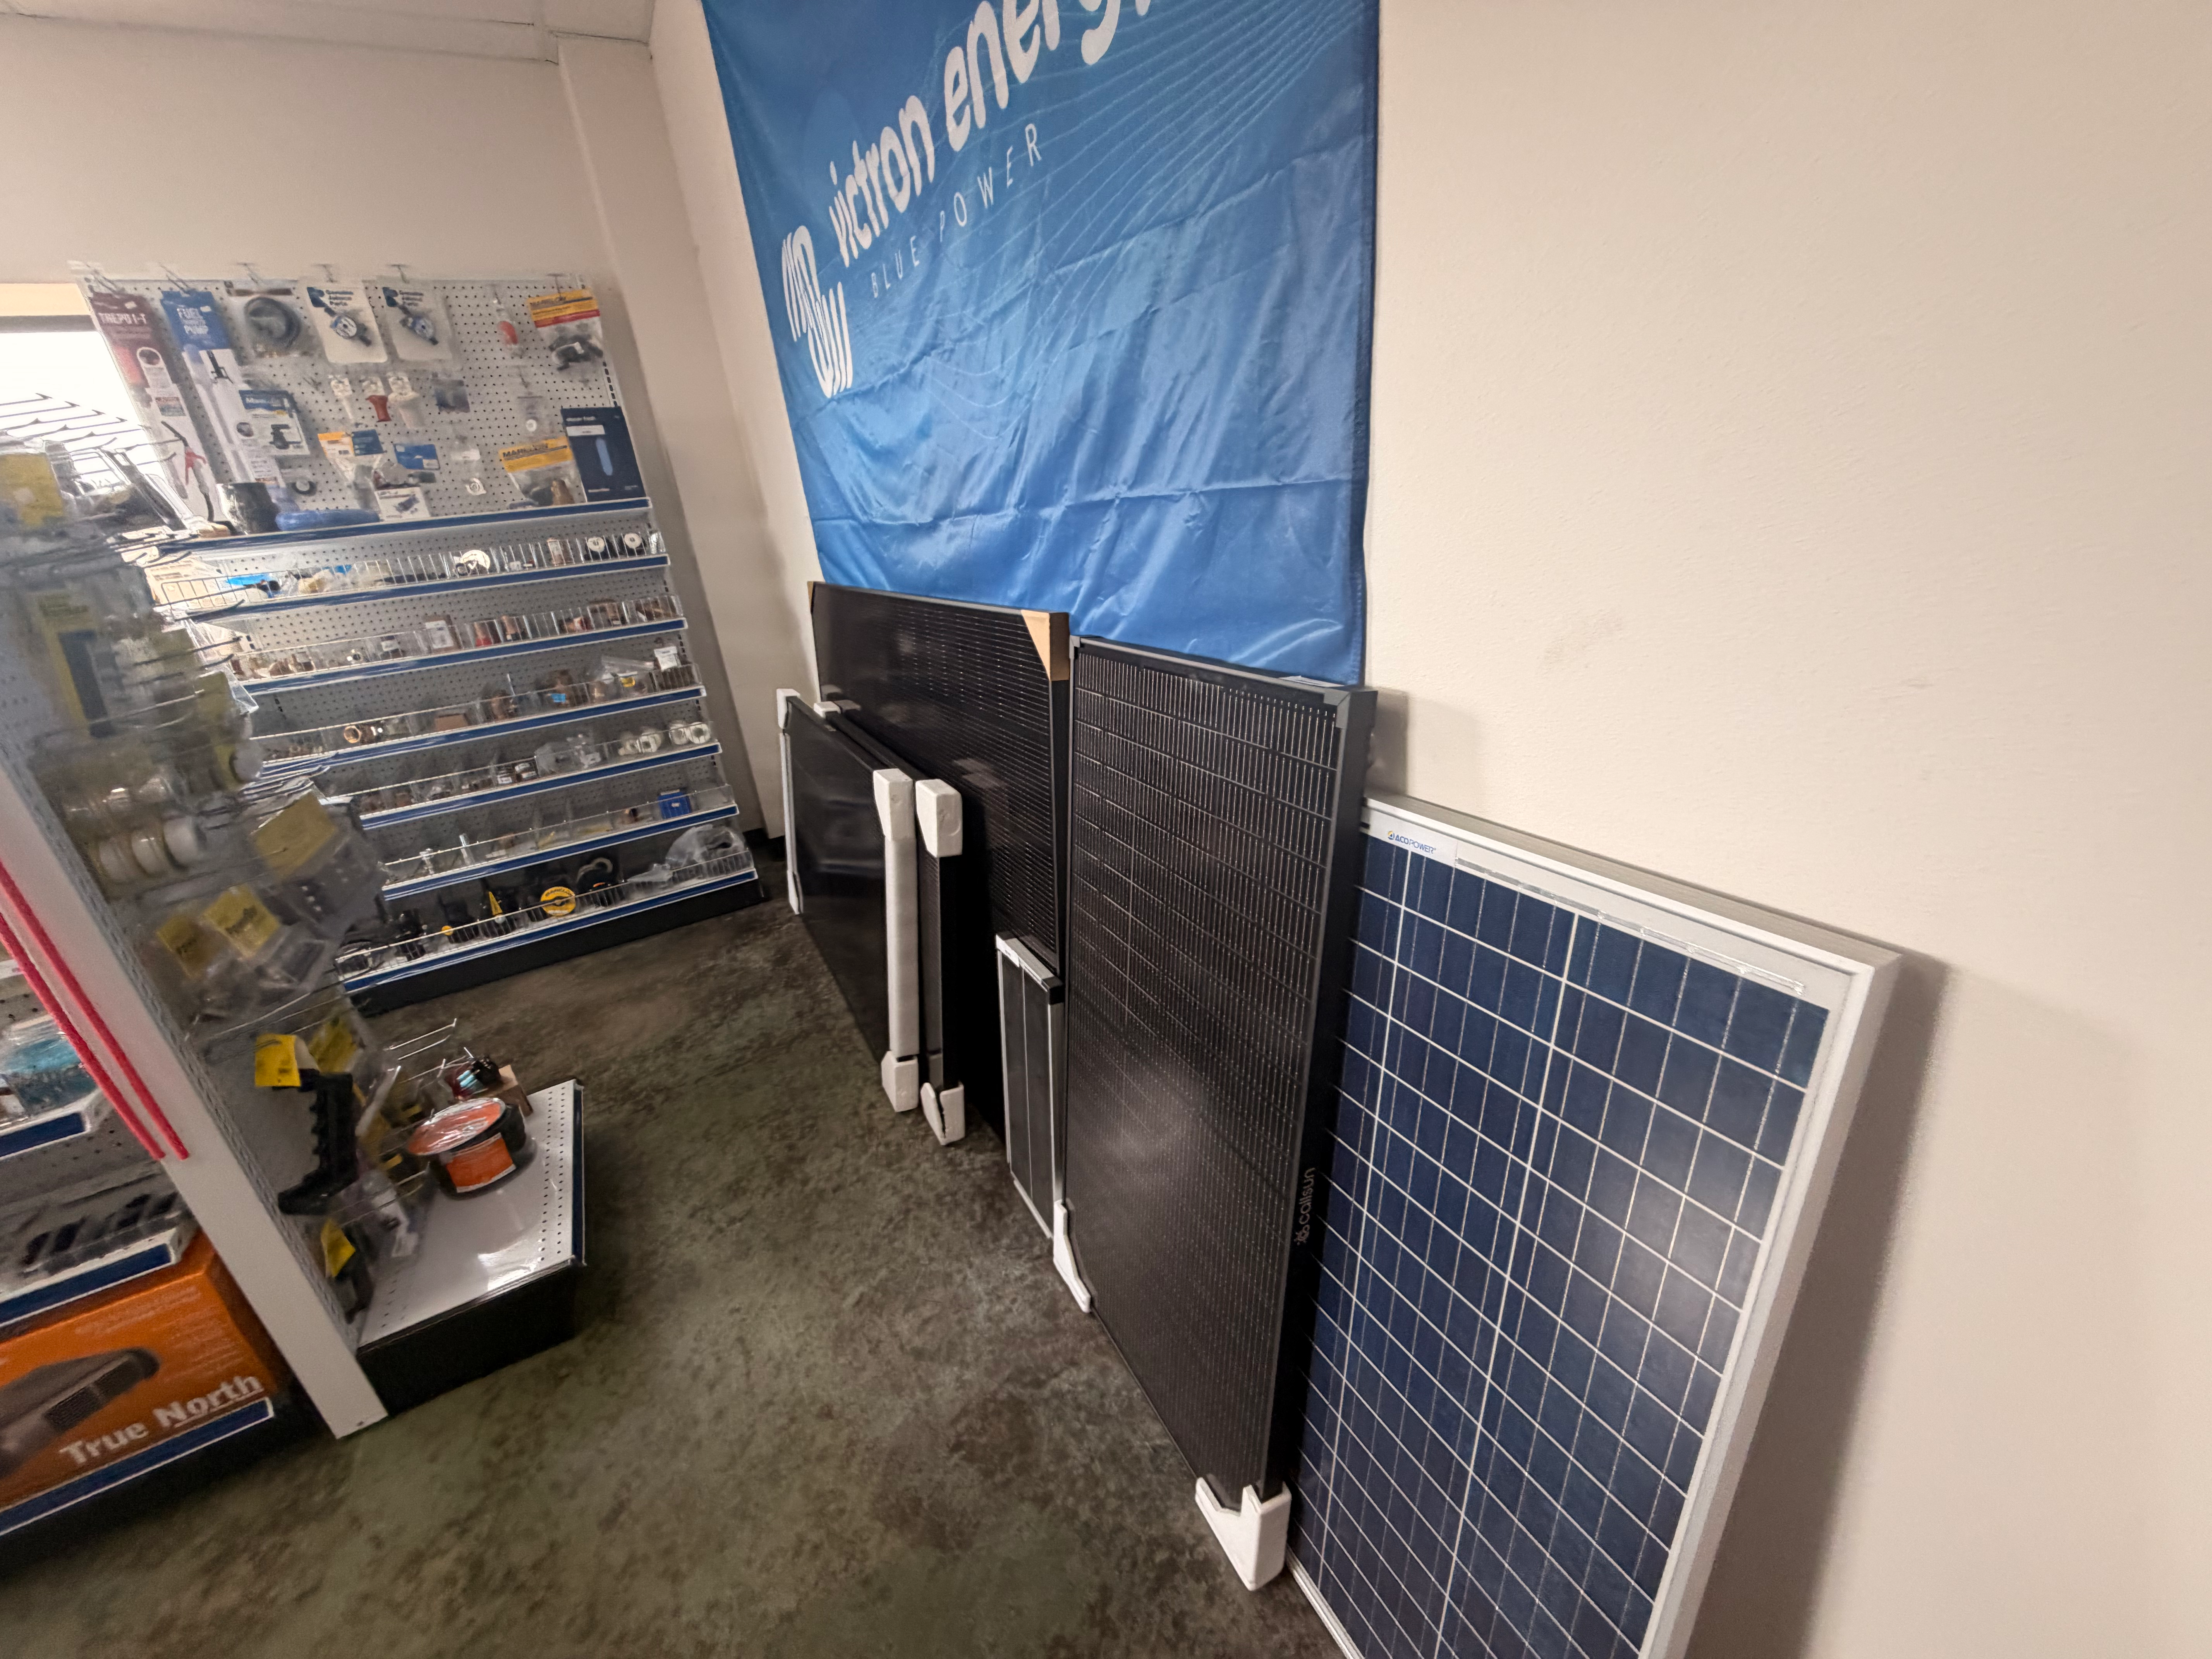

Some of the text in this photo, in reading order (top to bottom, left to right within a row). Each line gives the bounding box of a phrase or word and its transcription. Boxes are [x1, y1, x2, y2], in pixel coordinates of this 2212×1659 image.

[829, 0, 1151, 268] victron ene
[870, 124, 1042, 298] BLUE POWER
[1395, 834, 1434, 854] ACOPOWER
[59, 1376, 263, 1464] True North
